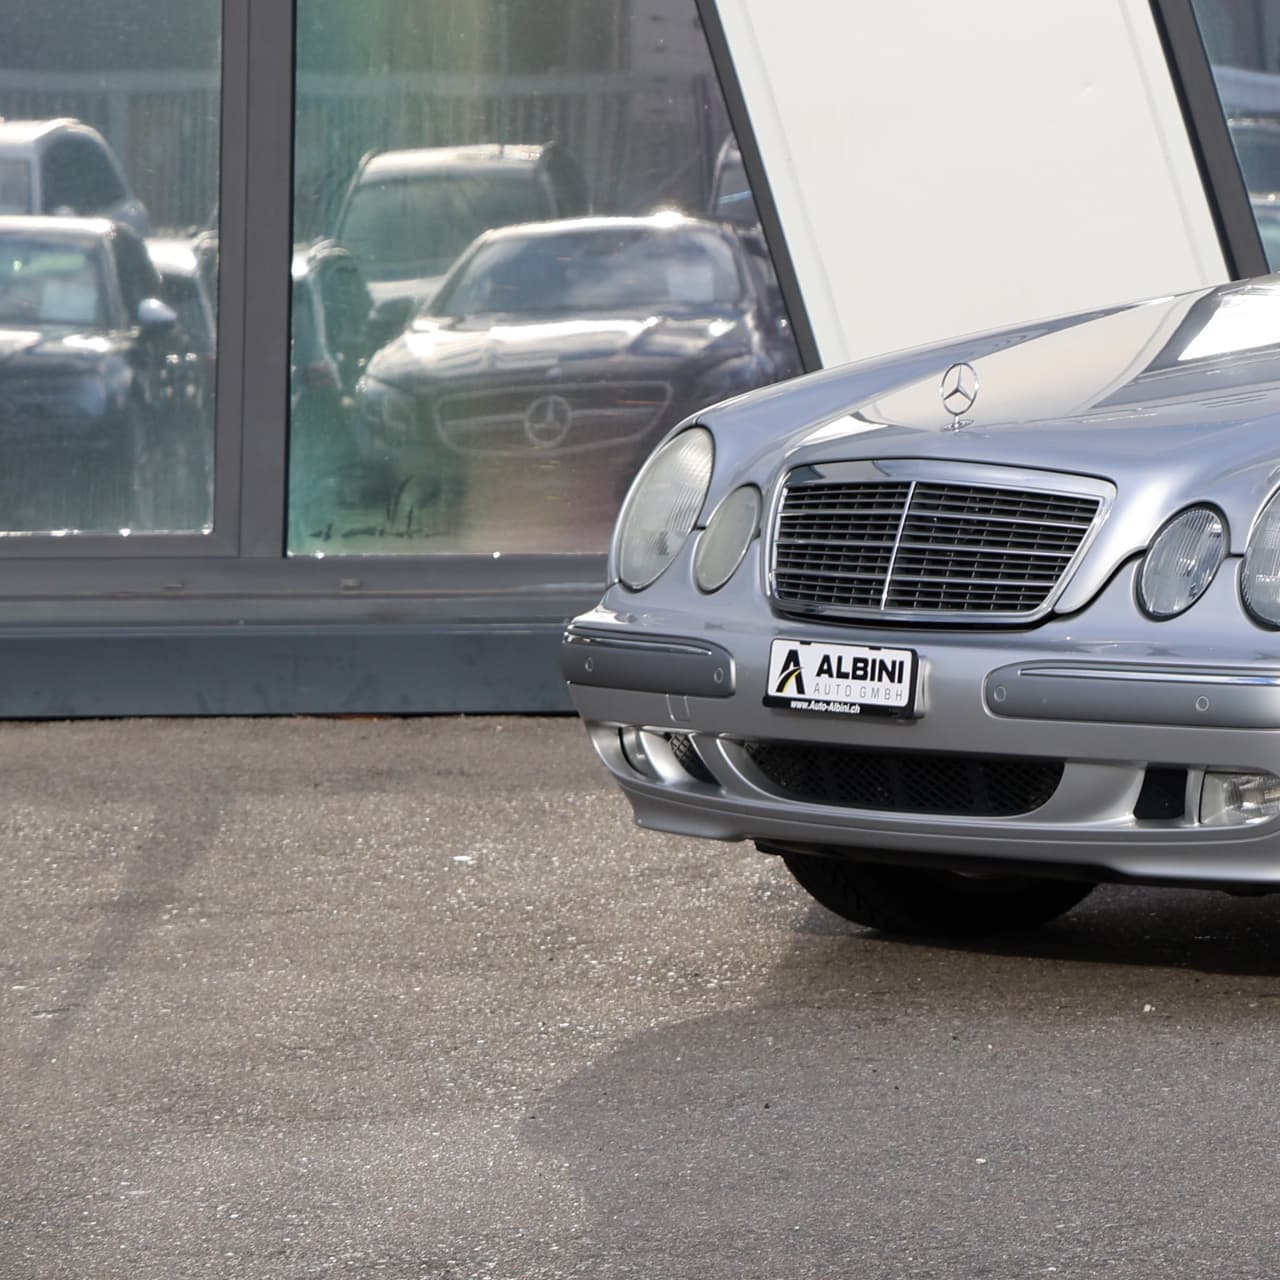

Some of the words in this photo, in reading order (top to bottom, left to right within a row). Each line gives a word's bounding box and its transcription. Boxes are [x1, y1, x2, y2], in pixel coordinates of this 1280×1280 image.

[815, 654, 905, 684] ALBINI
[813, 682, 852, 698] AUTO
[859, 686, 904, 702] GMBH
[790, 700, 861, 715] www.Auto-Albini.ch
